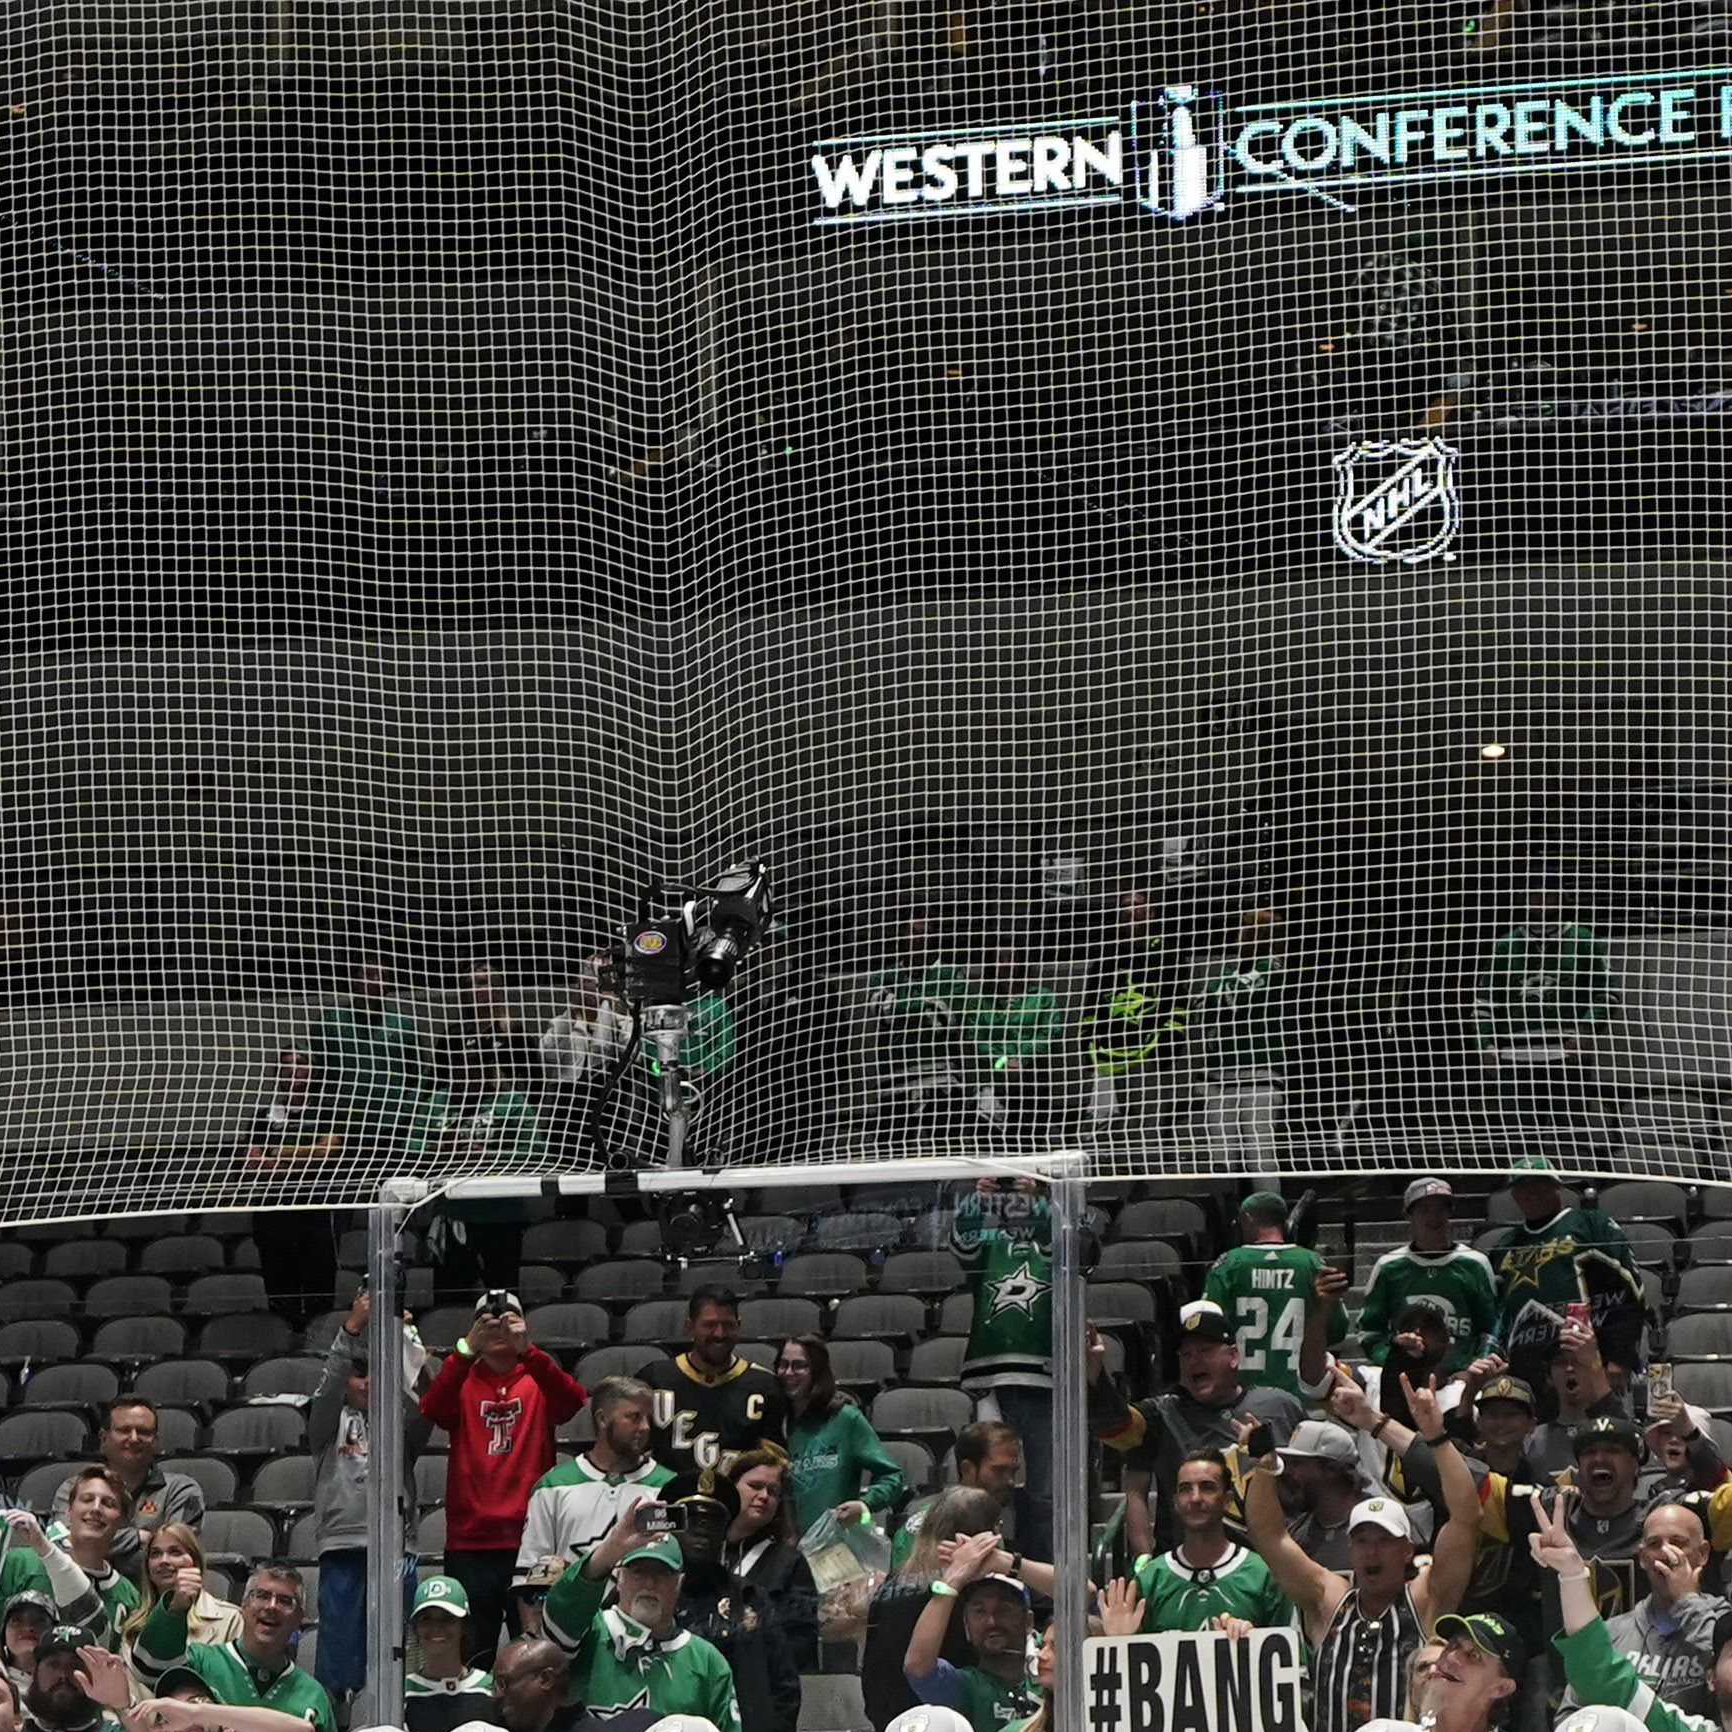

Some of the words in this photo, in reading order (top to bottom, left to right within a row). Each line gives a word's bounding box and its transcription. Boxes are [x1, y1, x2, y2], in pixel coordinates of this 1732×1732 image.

[812, 130, 1122, 208] WESTERN
[1235, 88, 1695, 174] CONFERENCE
[1252, 1267, 1295, 1290] HINTZ
[1235, 1296, 1305, 1371] 24
[746, 1393, 765, 1421] C
